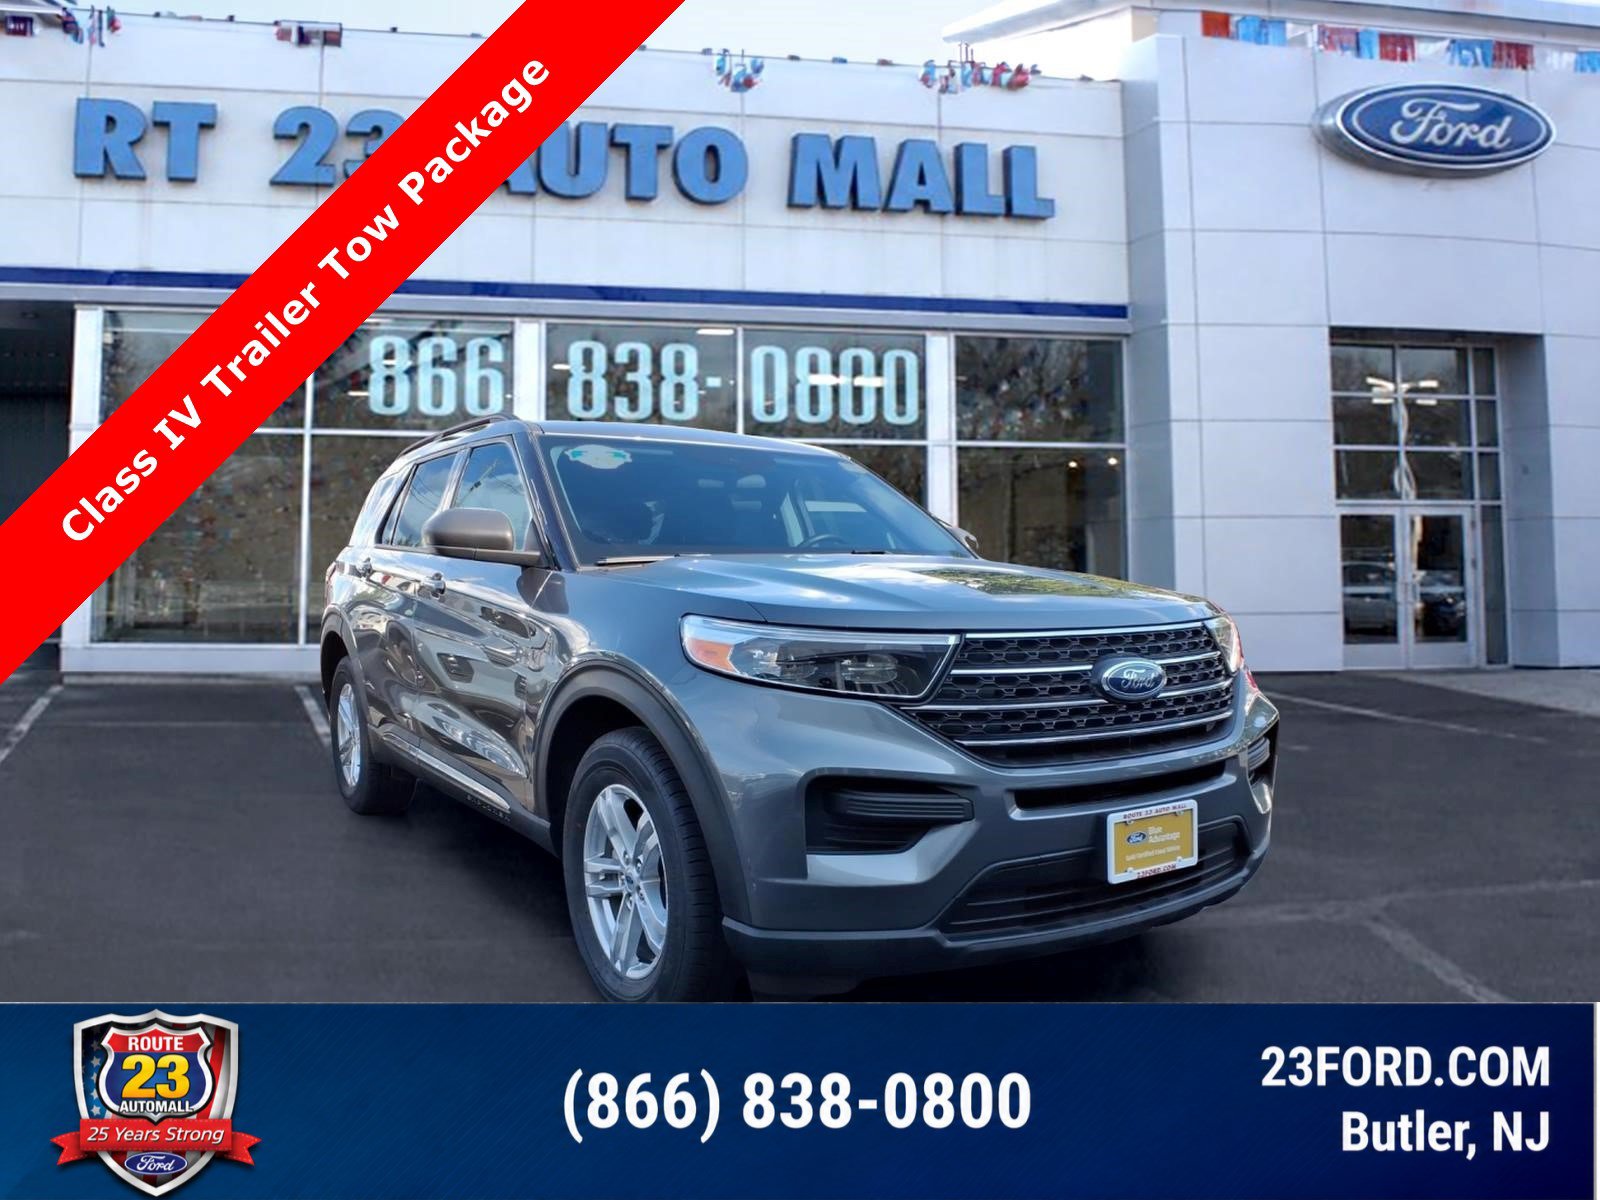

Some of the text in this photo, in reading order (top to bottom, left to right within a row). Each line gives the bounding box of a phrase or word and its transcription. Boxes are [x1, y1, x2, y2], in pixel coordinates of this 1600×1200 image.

[1390, 98, 1513, 150] Ford
[74, 97, 217, 182] RT
[787, 132, 1055, 220] MALL
[368, 335, 502, 418] 866
[1121, 668, 1157, 689] Ford
[1123, 811, 1143, 820] ROUTE
[1154, 806, 1171, 814] AUTO
